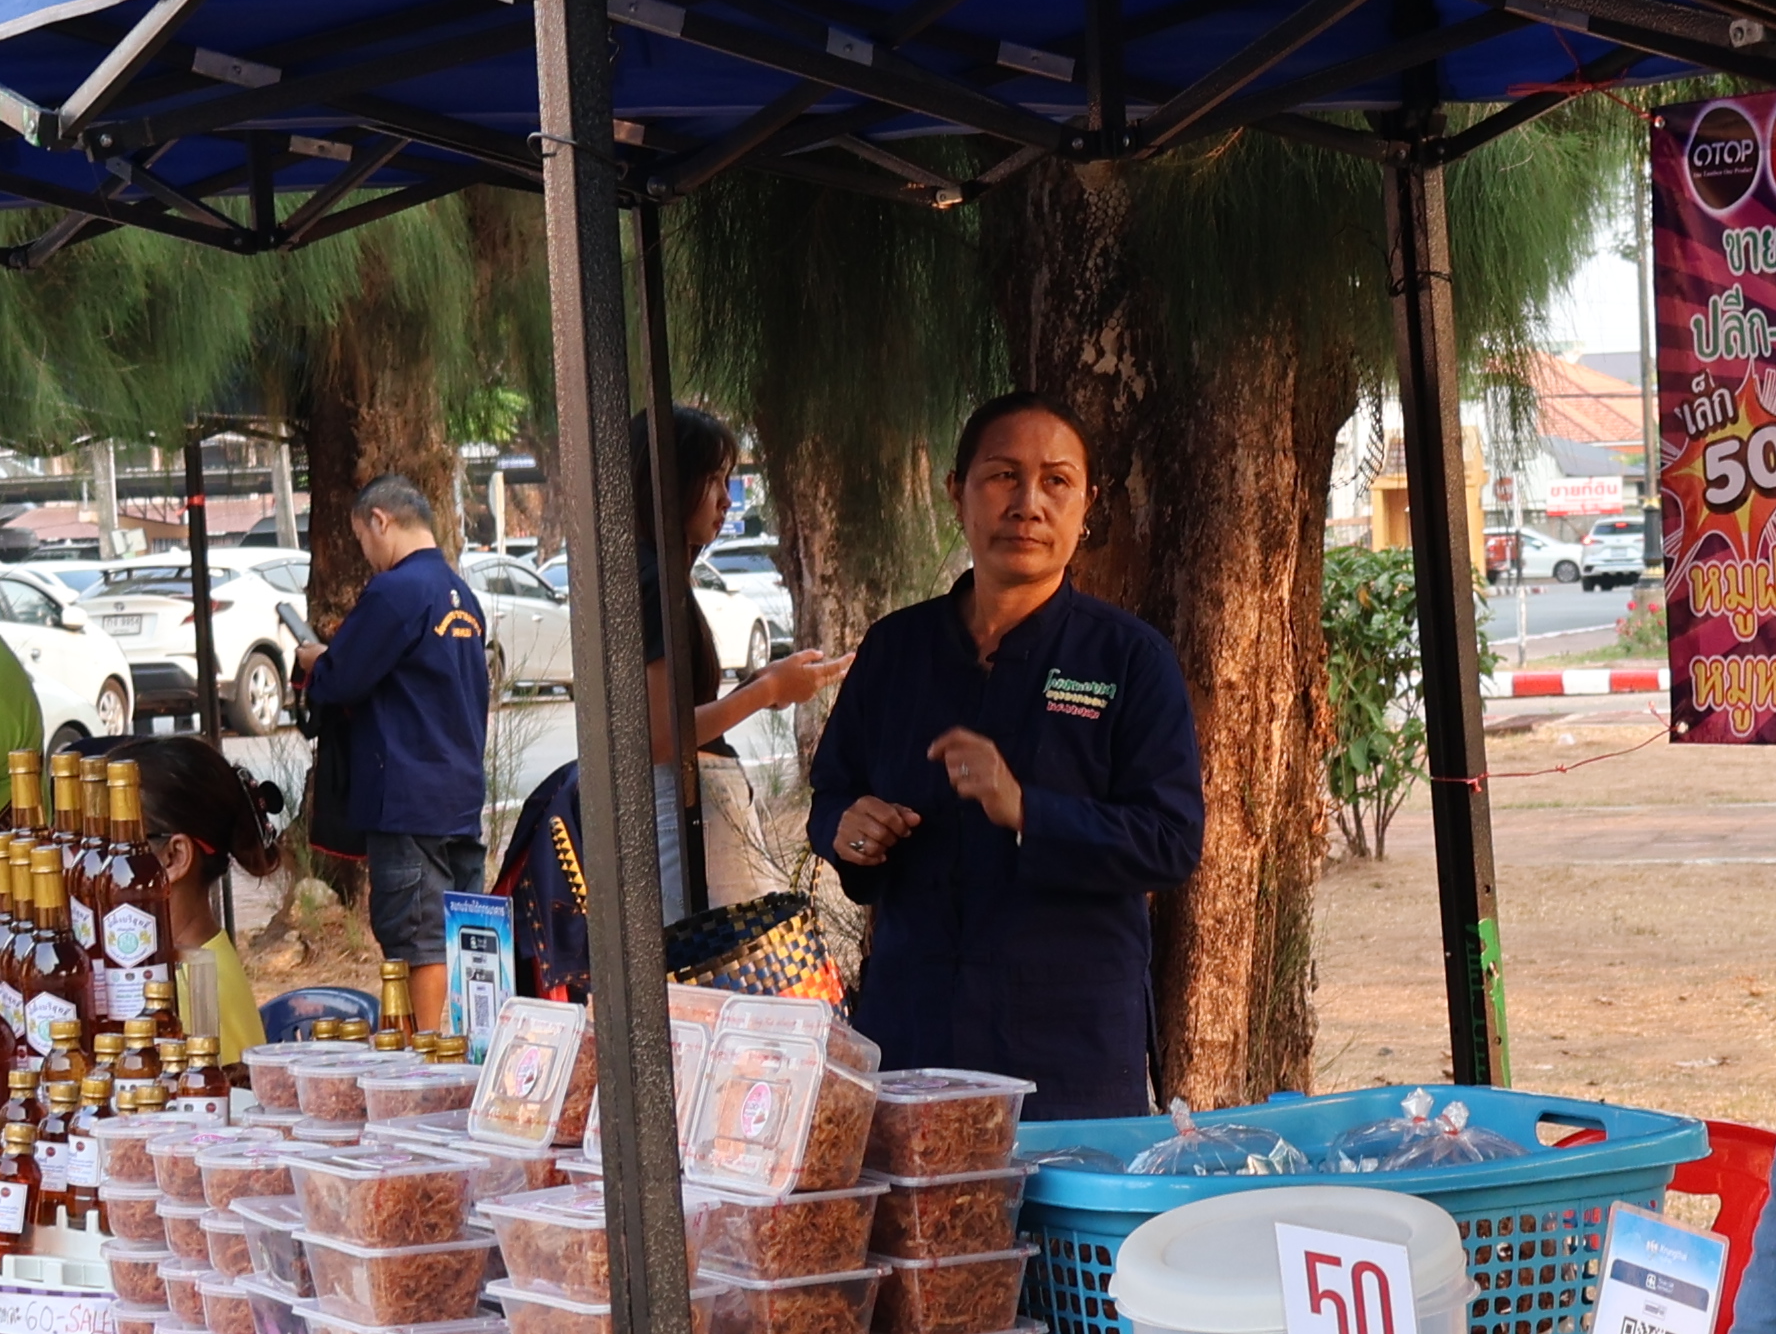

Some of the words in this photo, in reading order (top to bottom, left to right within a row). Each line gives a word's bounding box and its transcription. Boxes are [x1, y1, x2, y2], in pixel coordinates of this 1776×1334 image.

[1693, 139, 1754, 167] OTOP
[1679, 371, 1736, 436] เล็ก
[1550, 479, 1618, 498] ขายที่ดิน
